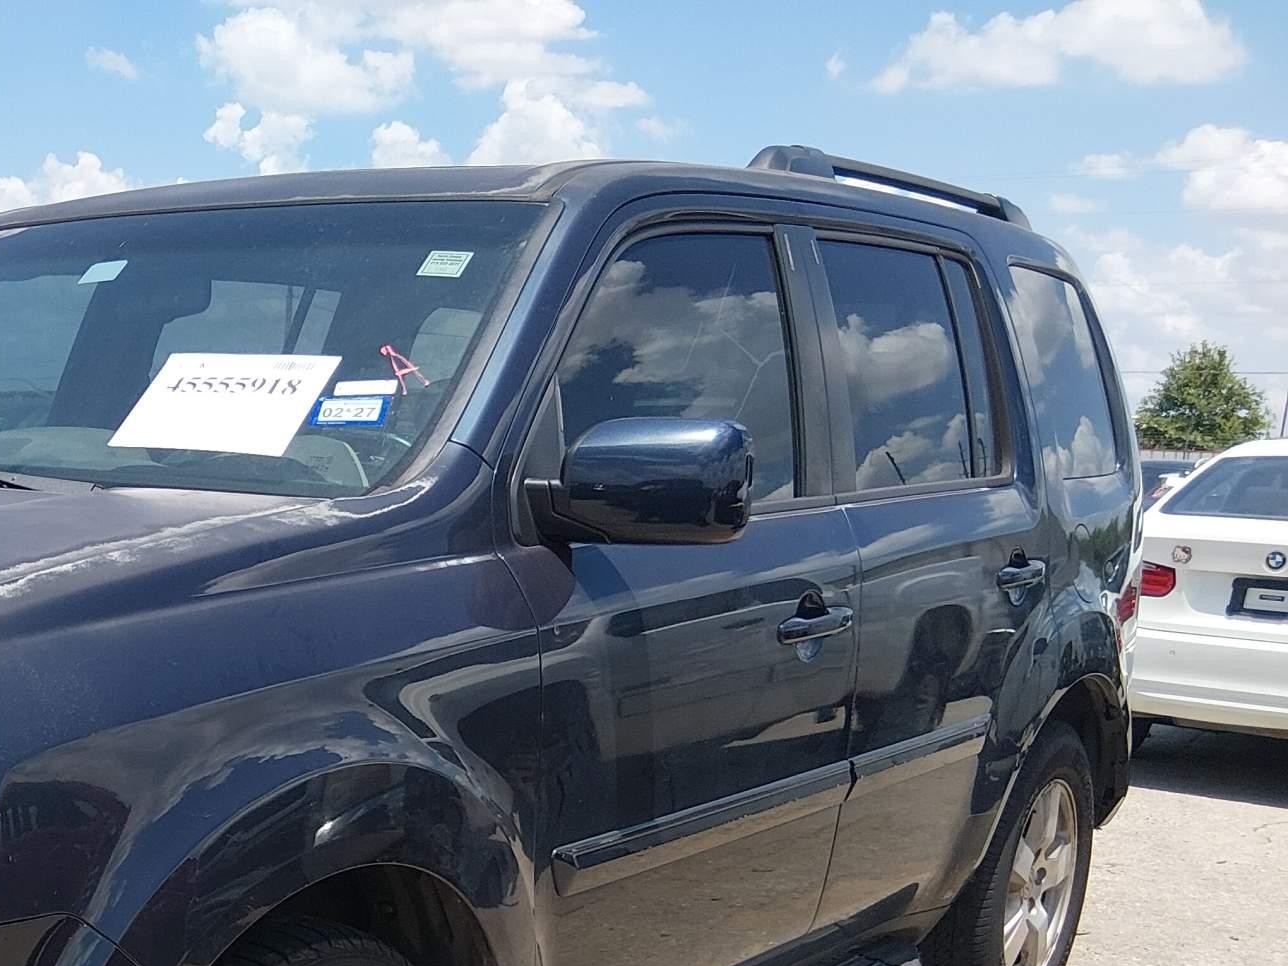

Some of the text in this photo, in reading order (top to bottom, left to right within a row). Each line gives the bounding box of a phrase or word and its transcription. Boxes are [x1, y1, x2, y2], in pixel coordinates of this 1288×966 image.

[167, 372, 302, 396] 45555918
[322, 407, 376, 418] 02 27
